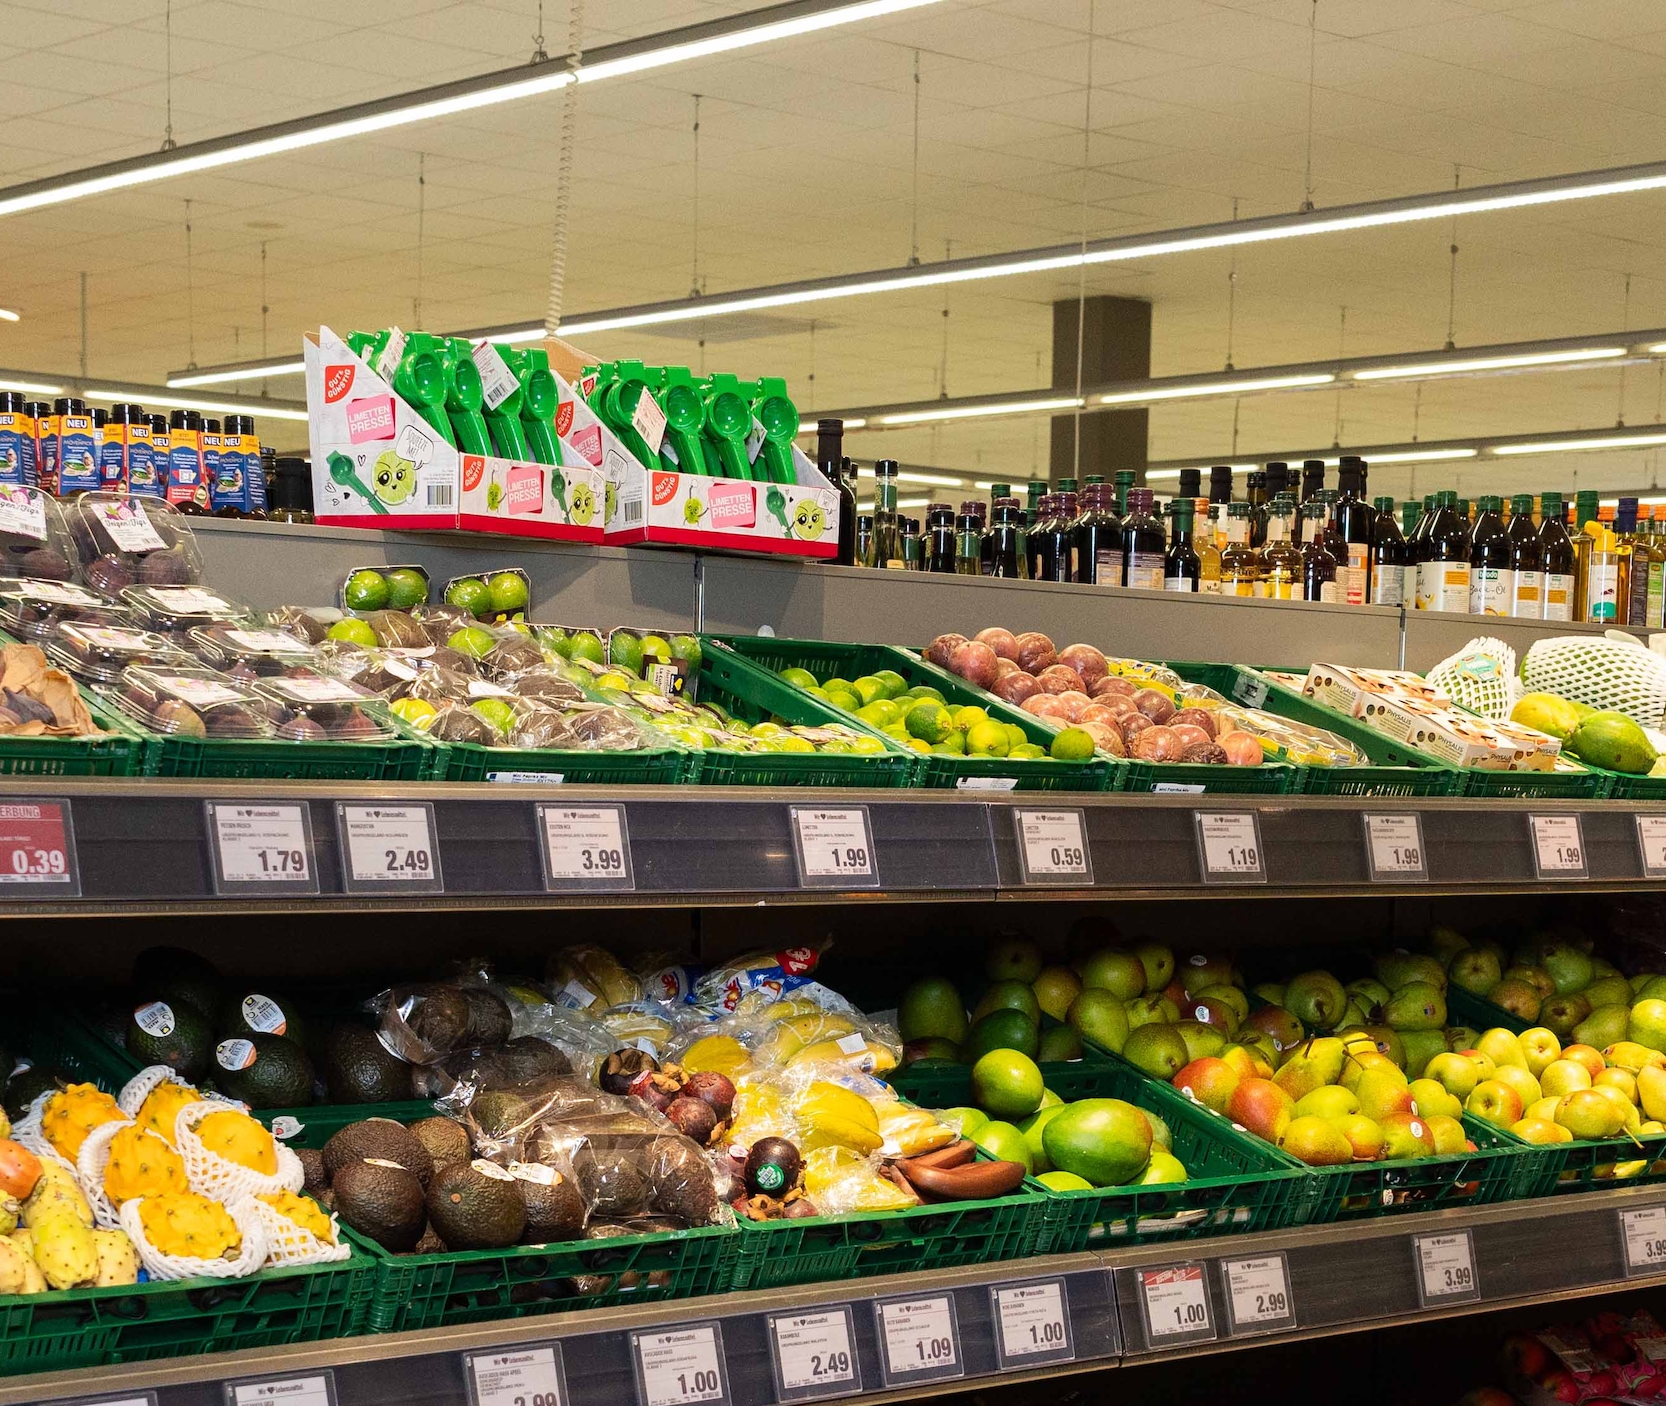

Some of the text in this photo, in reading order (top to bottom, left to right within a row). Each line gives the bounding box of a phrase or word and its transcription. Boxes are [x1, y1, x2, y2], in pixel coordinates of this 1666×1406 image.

[66, 418, 88, 429] NEU
[349, 405, 391, 425] LIMETTEN
[351, 415, 392, 434] PRESSE
[132, 427, 149, 438] NEU
[224, 437, 240, 447] NEU
[508, 478, 540, 492] LIMETTEN
[509, 487, 540, 504] PRESSE
[711, 493, 752, 507] LIMETTEN
[712, 501, 753, 520] PRESSE
[1333, 681, 1357, 699] PHYSALIS
[1387, 709, 1412, 726] PHYSALIS
[1437, 735, 1463, 752] PHYSALIS
[1535, 746, 1558, 756] PHYSALIS
[1490, 753, 1512, 761] PHYSALIS
[13, 850, 66, 873] 0.39
[257, 851, 304, 872] 1.79
[386, 850, 429, 871] 2.49
[582, 849, 621, 870] 3.99
[832, 848, 867, 867] 1.99
[1051, 848, 1082, 866] 0.59
[1228, 848, 1257, 867] 1.19
[1393, 849, 1420, 866] 1.99
[1557, 848, 1581, 863] 1.99
[1444, 1267, 1471, 1287] 3.99
[1256, 1293, 1286, 1313] 2.99
[1174, 1305, 1205, 1325] 1.00
[1030, 1322, 1063, 1343] 1.00
[916, 1338, 952, 1360] 1.09
[811, 1352, 849, 1376] 2.49
[677, 1370, 718, 1395] 1.00
